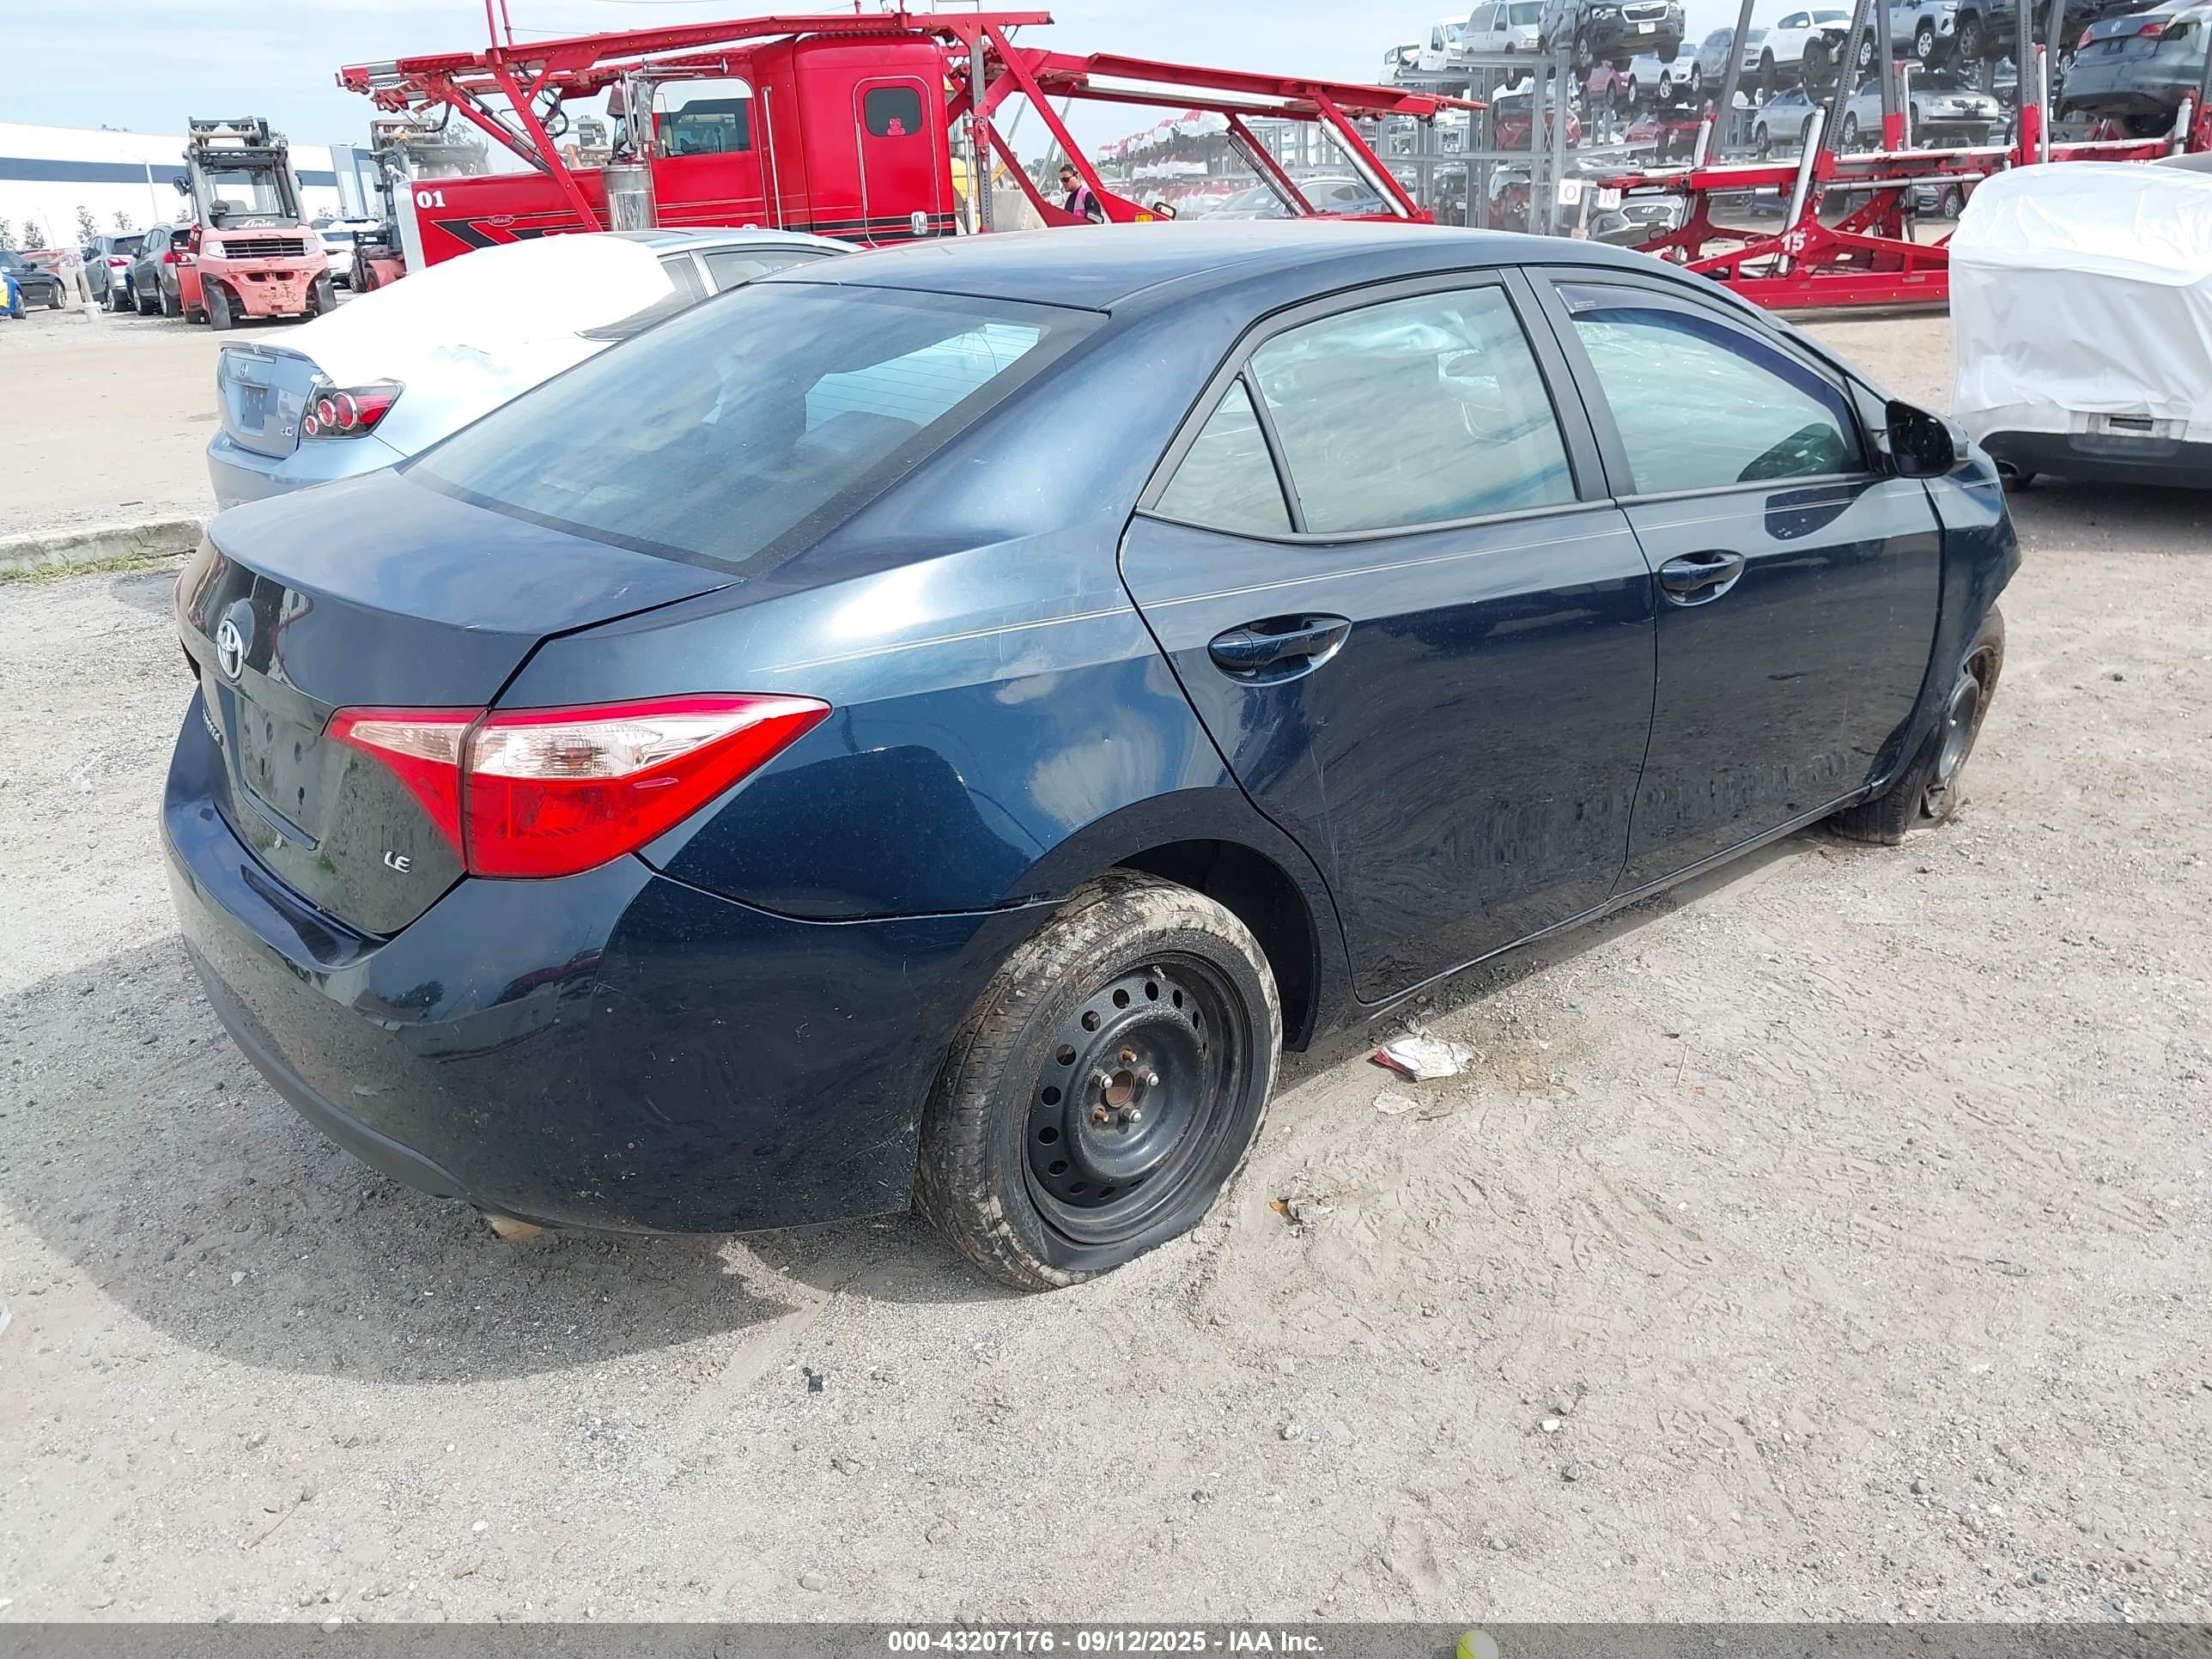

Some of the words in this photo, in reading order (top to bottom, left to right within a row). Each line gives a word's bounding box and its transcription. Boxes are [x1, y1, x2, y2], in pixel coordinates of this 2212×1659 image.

[416, 191, 446, 208] 01
[1781, 233, 1807, 251] 15
[384, 850, 411, 873] LE
